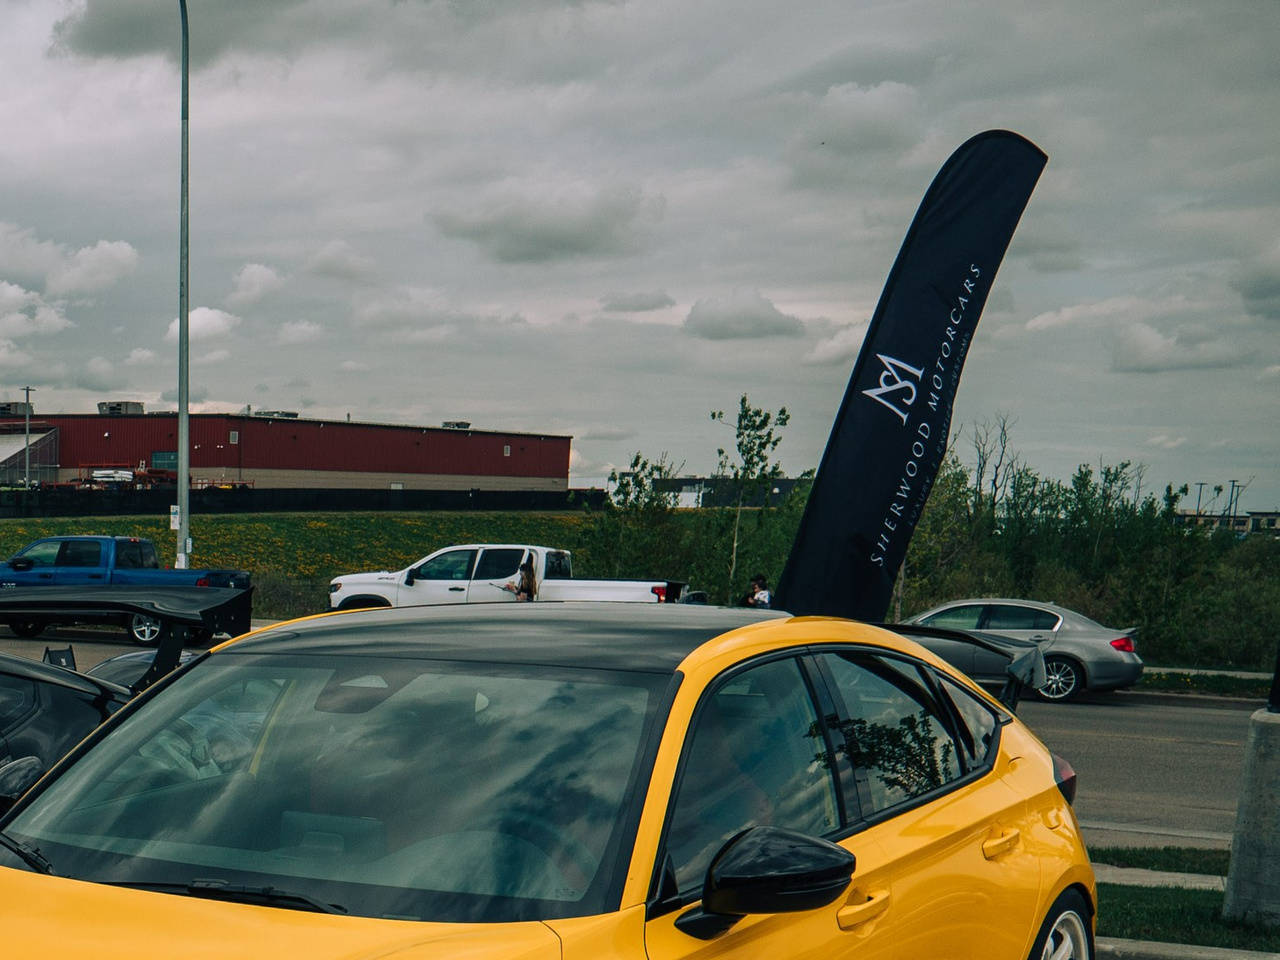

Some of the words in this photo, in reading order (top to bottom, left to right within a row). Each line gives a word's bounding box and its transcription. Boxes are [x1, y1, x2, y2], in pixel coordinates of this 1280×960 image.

[870, 422, 931, 567] SHERWOOD
[927, 263, 981, 412] MOTORCARS
[908, 476, 931, 527] LUXURY
